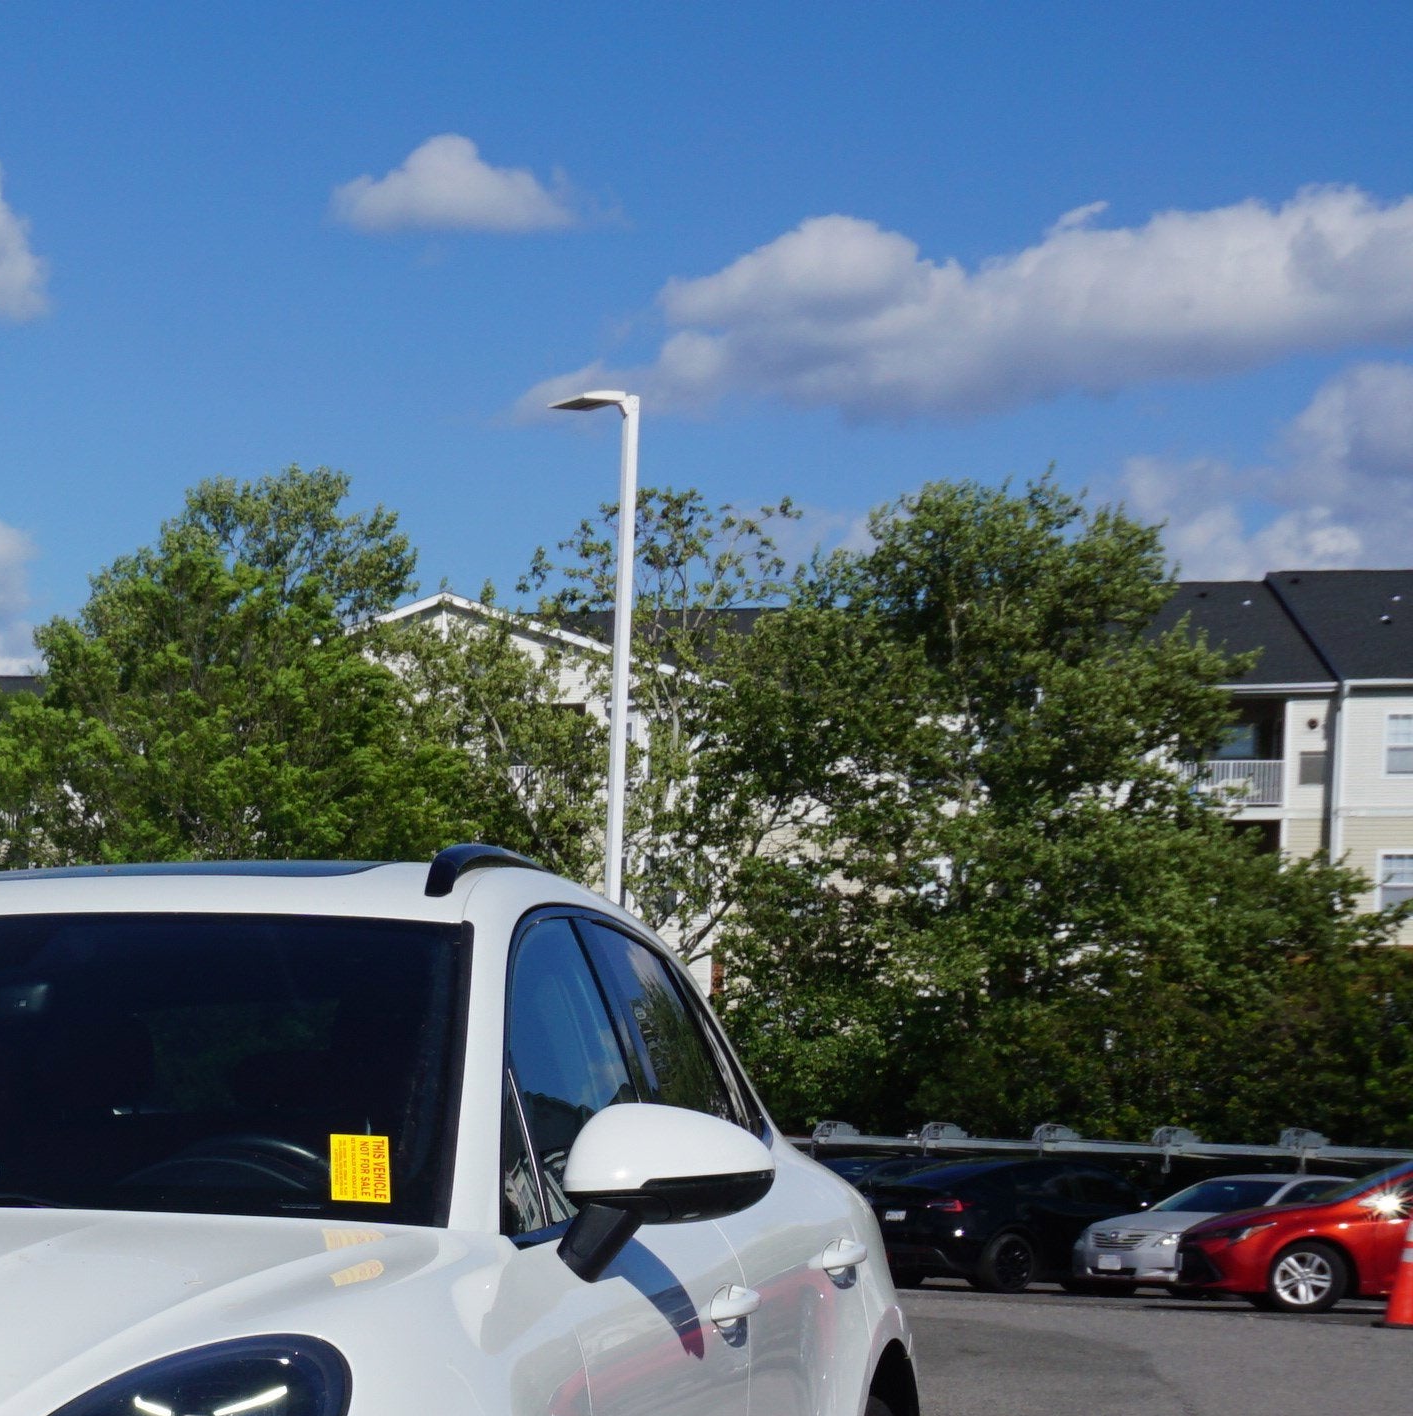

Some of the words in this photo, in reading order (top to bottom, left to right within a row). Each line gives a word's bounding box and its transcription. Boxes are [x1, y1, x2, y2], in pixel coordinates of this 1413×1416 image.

[360, 1141, 369, 1156] NOT
[372, 1140, 385, 1159] THIS
[360, 1159, 369, 1174] FOR
[361, 1177, 370, 1196] SALE
[374, 1162, 386, 1199] VEHICLE
